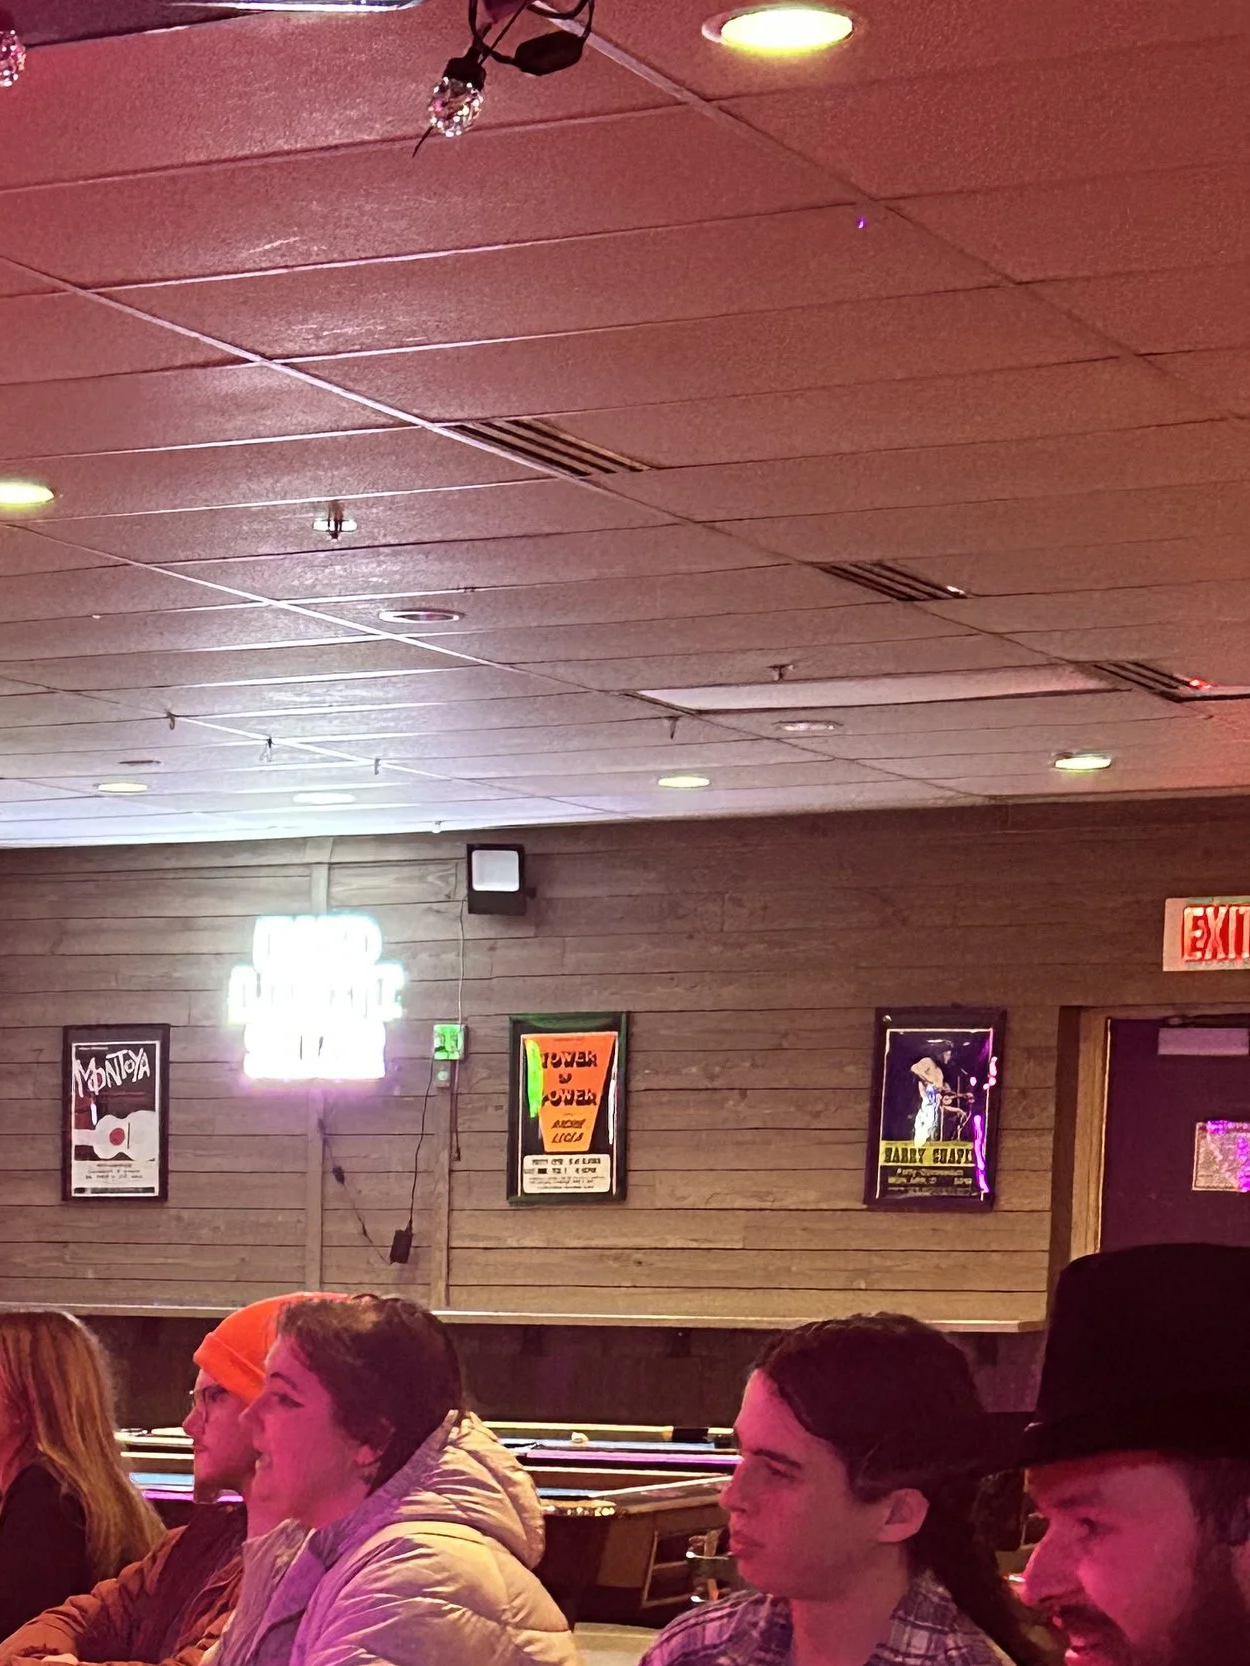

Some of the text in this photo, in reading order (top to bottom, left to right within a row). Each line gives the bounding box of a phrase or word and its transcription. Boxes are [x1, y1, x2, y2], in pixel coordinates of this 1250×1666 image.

[1182, 905, 1250, 960] EXIT
[73, 1047, 150, 1098] MONTOYA
[883, 1147, 926, 1164] HARRY
